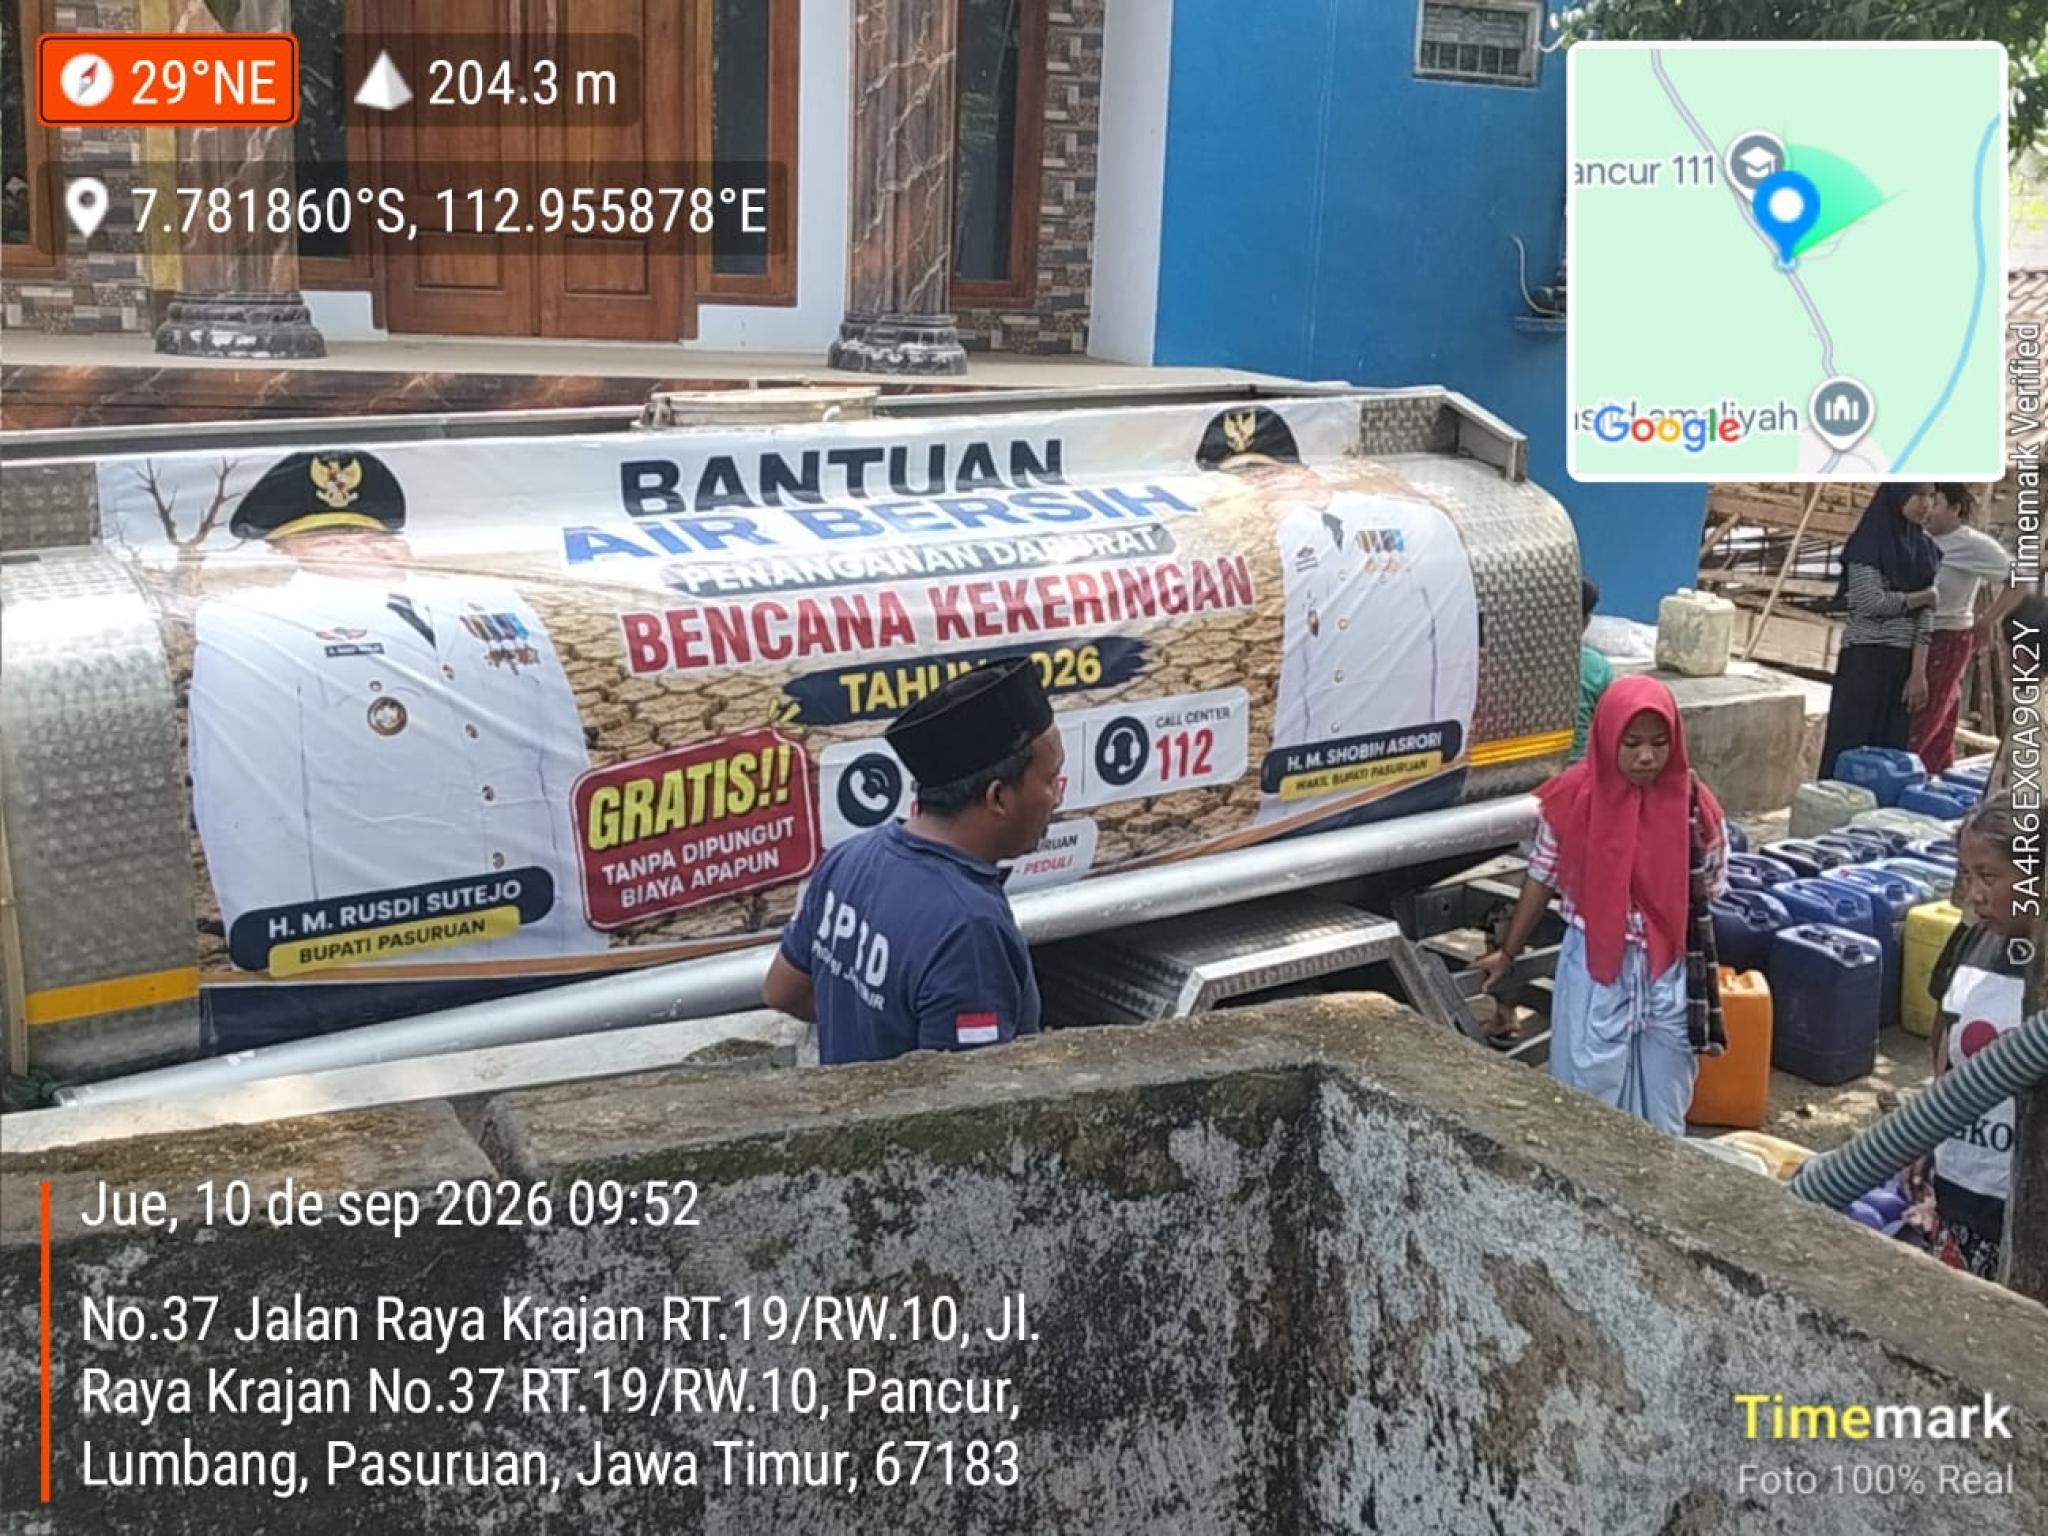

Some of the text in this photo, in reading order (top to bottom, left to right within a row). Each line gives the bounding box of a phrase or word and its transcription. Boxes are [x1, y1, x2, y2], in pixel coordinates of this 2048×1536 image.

[620, 438, 1072, 517] BANTUAN
[563, 484, 1198, 565] AIR BERSIH
[682, 542, 984, 592] PENANGANAN
[622, 555, 1254, 674] BENCANA KEKERINGAN
[1030, 645, 1103, 689] 026
[1155, 706, 1231, 728] CALL CENTER
[1155, 729, 1214, 781] 112
[1286, 731, 1442, 772] H. M. SHOBIH ASRORI
[588, 744, 792, 851] GRATIS!!
[602, 817, 795, 885] TANPA DIPUNGUT
[621, 849, 780, 908] BIAYA APAPUN
[1023, 856, 1074, 875] PEDULI
[268, 879, 522, 938] H. M. RUSDI SUTEJO
[299, 919, 486, 964] BUPATI PASURUAN
